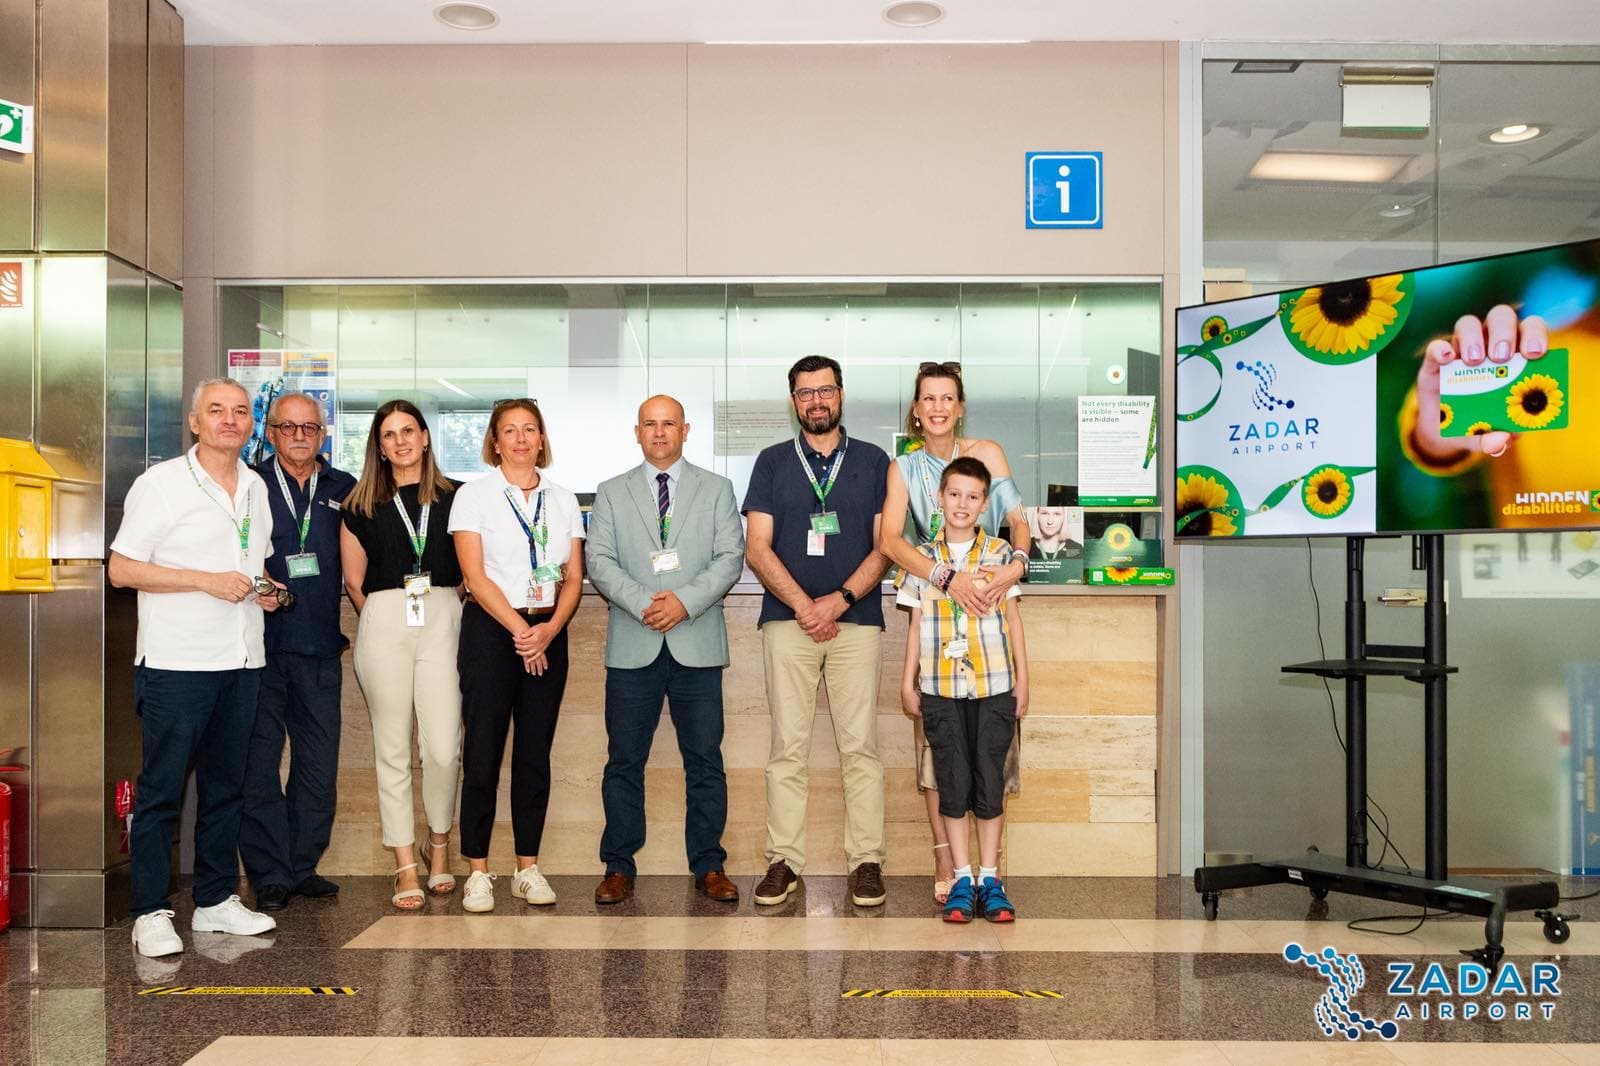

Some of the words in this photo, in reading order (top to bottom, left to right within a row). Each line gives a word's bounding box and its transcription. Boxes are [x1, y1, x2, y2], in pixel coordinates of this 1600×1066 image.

[1055, 164, 1071, 214] i
[1118, 400, 1150, 408] disability
[1229, 417, 1319, 442] ZADAR
[1232, 441, 1317, 455] AIRPORT
[1515, 490, 1590, 505] HIDDEN
[1502, 502, 1582, 516] disabilities
